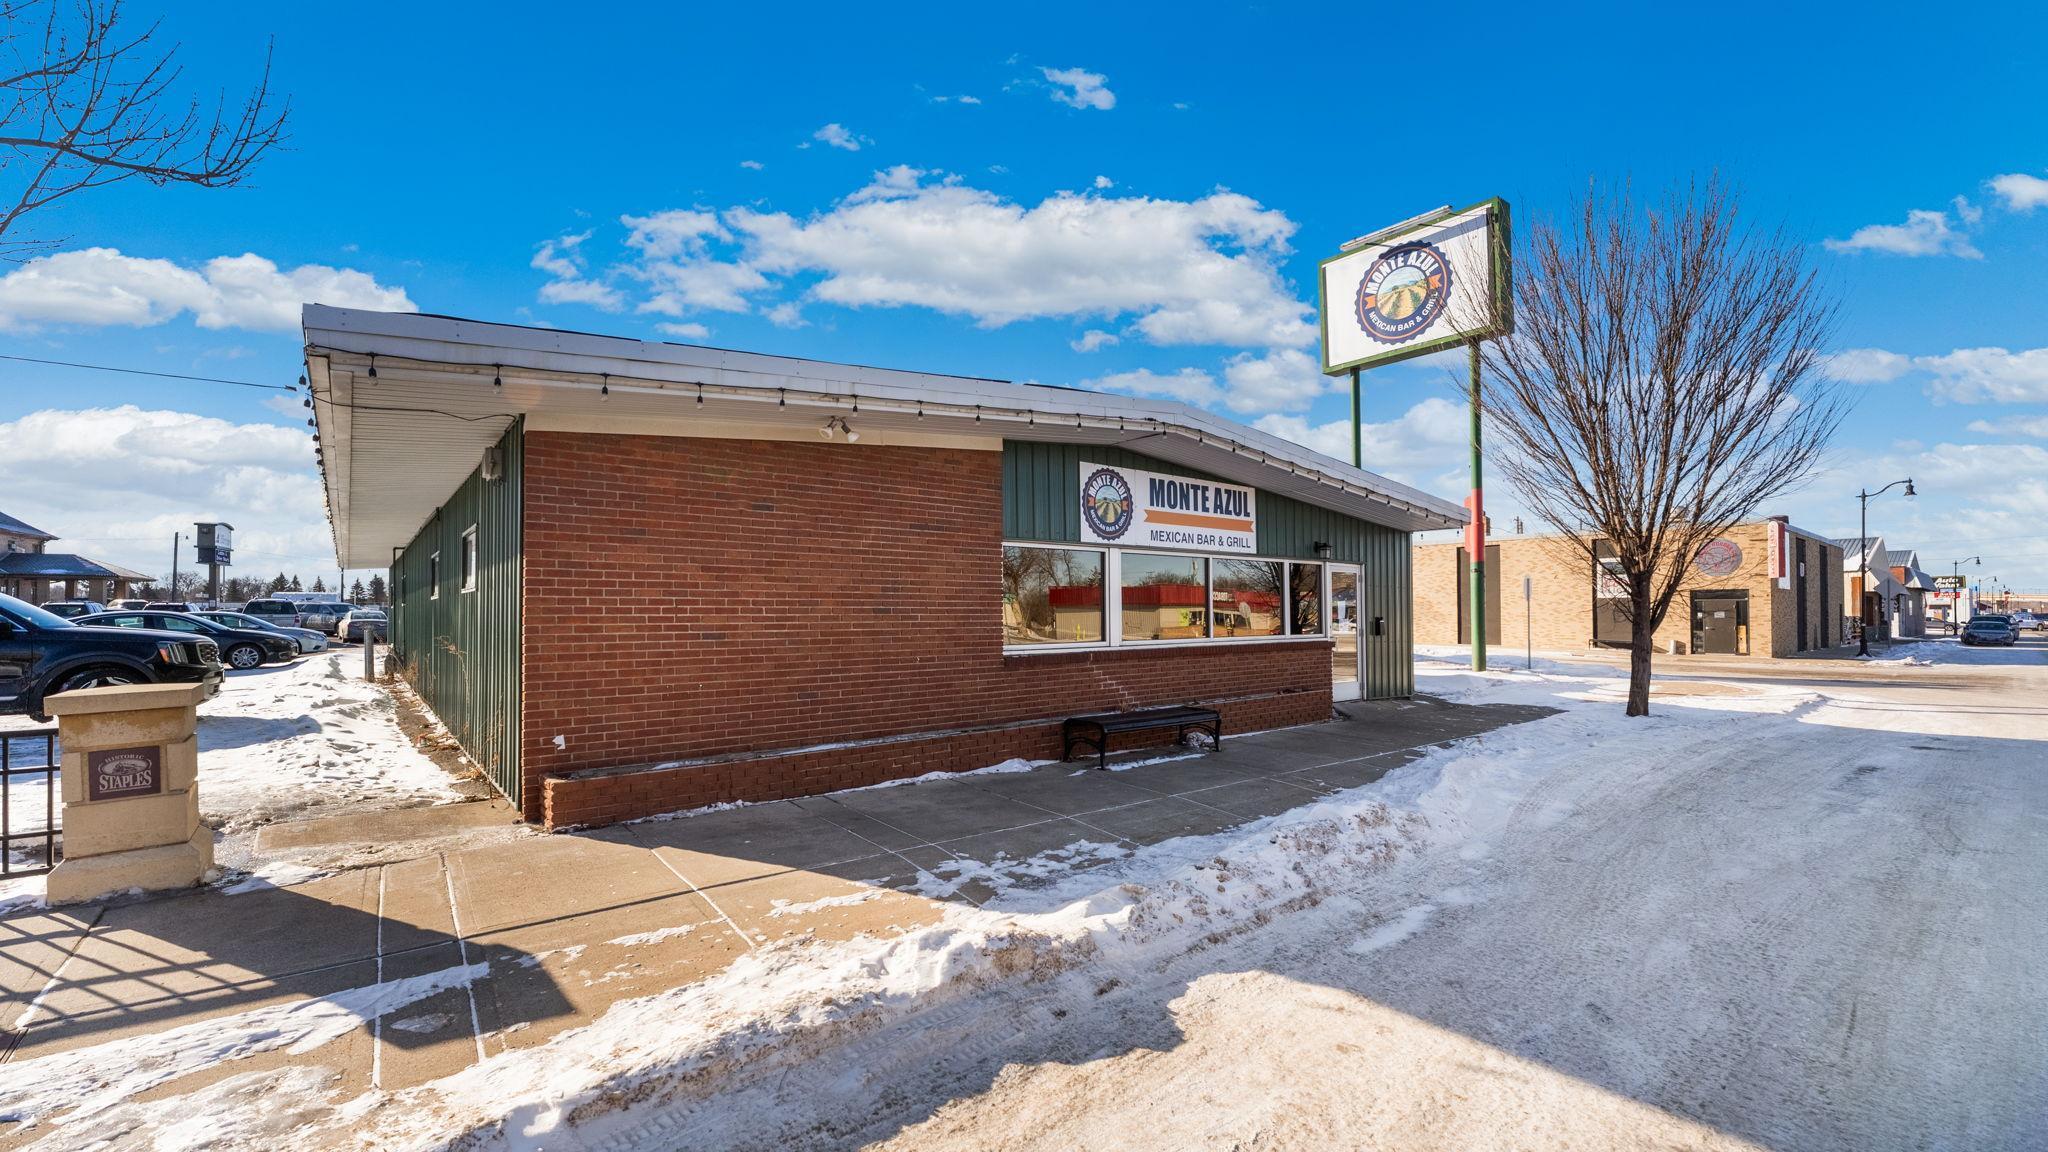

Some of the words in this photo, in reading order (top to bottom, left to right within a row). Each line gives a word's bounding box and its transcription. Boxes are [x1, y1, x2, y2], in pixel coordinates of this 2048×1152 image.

[1365, 253, 1404, 294] MONTE
[1407, 251, 1439, 276] AZUL
[1369, 311, 1397, 331] MEXICAN
[1397, 321, 1415, 331] BAR
[1089, 475, 1110, 497] MONTE
[1112, 478, 1127, 499] AZUL
[1149, 477, 1210, 513] MONTE
[1213, 487, 1251, 517] AZUL
[1090, 509, 1105, 530] MEXICAN
[1150, 530, 1194, 544] MEXICAN
[1196, 534, 1216, 546] BAR
[1217, 535, 1224, 546] &
[1226, 536, 1251, 549] GRILL
[99, 769, 152, 791] STAPLES
